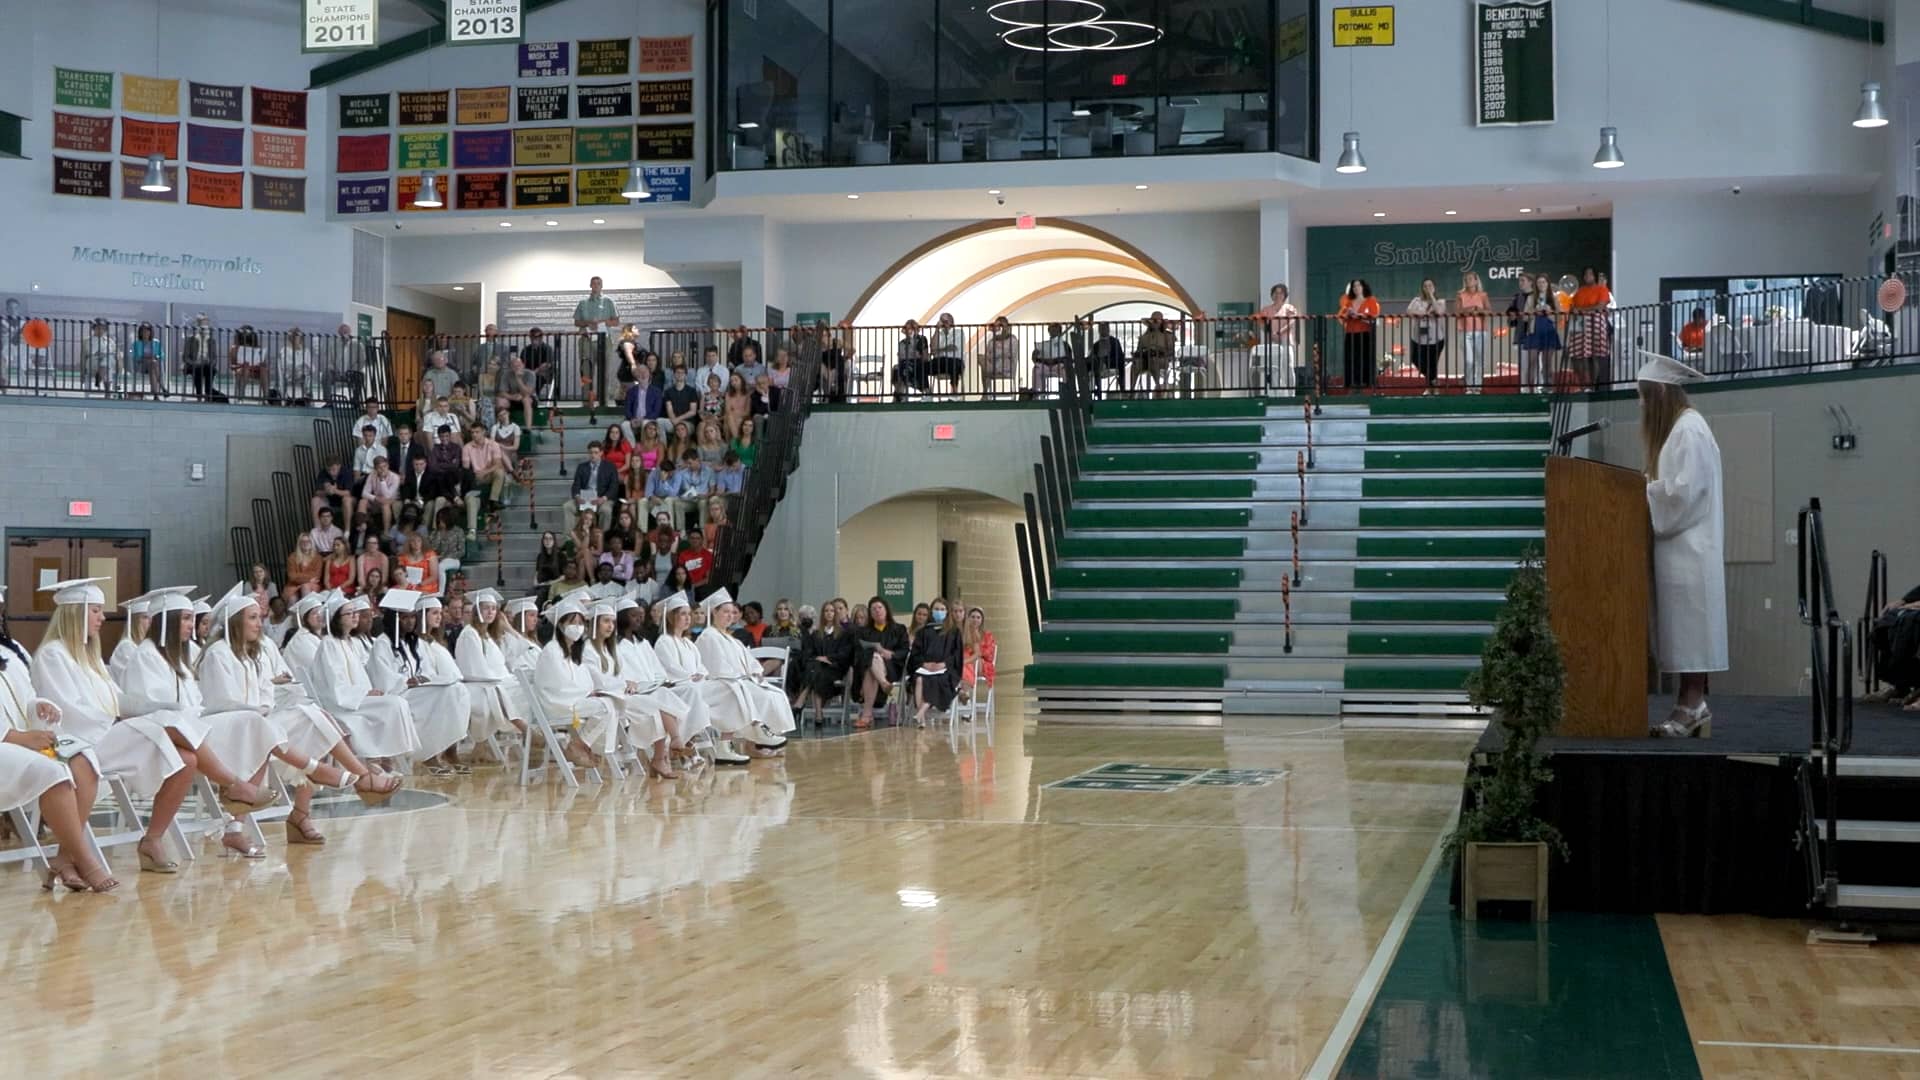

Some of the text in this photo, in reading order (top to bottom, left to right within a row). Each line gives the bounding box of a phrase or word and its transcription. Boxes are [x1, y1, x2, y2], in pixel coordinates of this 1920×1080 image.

[324, 4, 356, 14] STATE
[454, 5, 518, 17] CHAMPIONS
[1485, 7, 1546, 21] BENEDICTINE
[309, 13, 371, 24] CHAMPIONS
[457, 17, 515, 36] 2013
[1338, 22, 1390, 33] POTOMAC MD
[314, 24, 367, 44] 2011
[1483, 29, 1526, 41] 1975 2012
[58, 70, 110, 82] CHARLESTON
[1484, 66, 1503, 75] 2001
[63, 80, 104, 91] CATHOLIC
[200, 87, 233, 98] CANEVIN
[519, 87, 567, 97] GERMANTOWN
[350, 99, 380, 109] NICHOLS
[526, 95, 560, 104] ACADEMY
[588, 96, 622, 106] ACADEMY
[1484, 100, 1505, 110] 2007
[596, 106, 616, 115] 1993
[1484, 109, 1505, 120] 2010
[264, 144, 295, 155] GIBBONS
[73, 170, 94, 180] TECH
[644, 166, 686, 177] THE MILLER
[650, 177, 679, 187] SCHOOL
[363, 185, 386, 194] JOSEPH
[1374, 235, 1541, 273] Smithfield
[72, 246, 265, 274] McMurtrie-Reynolds
[131, 271, 206, 292] Pavilion
